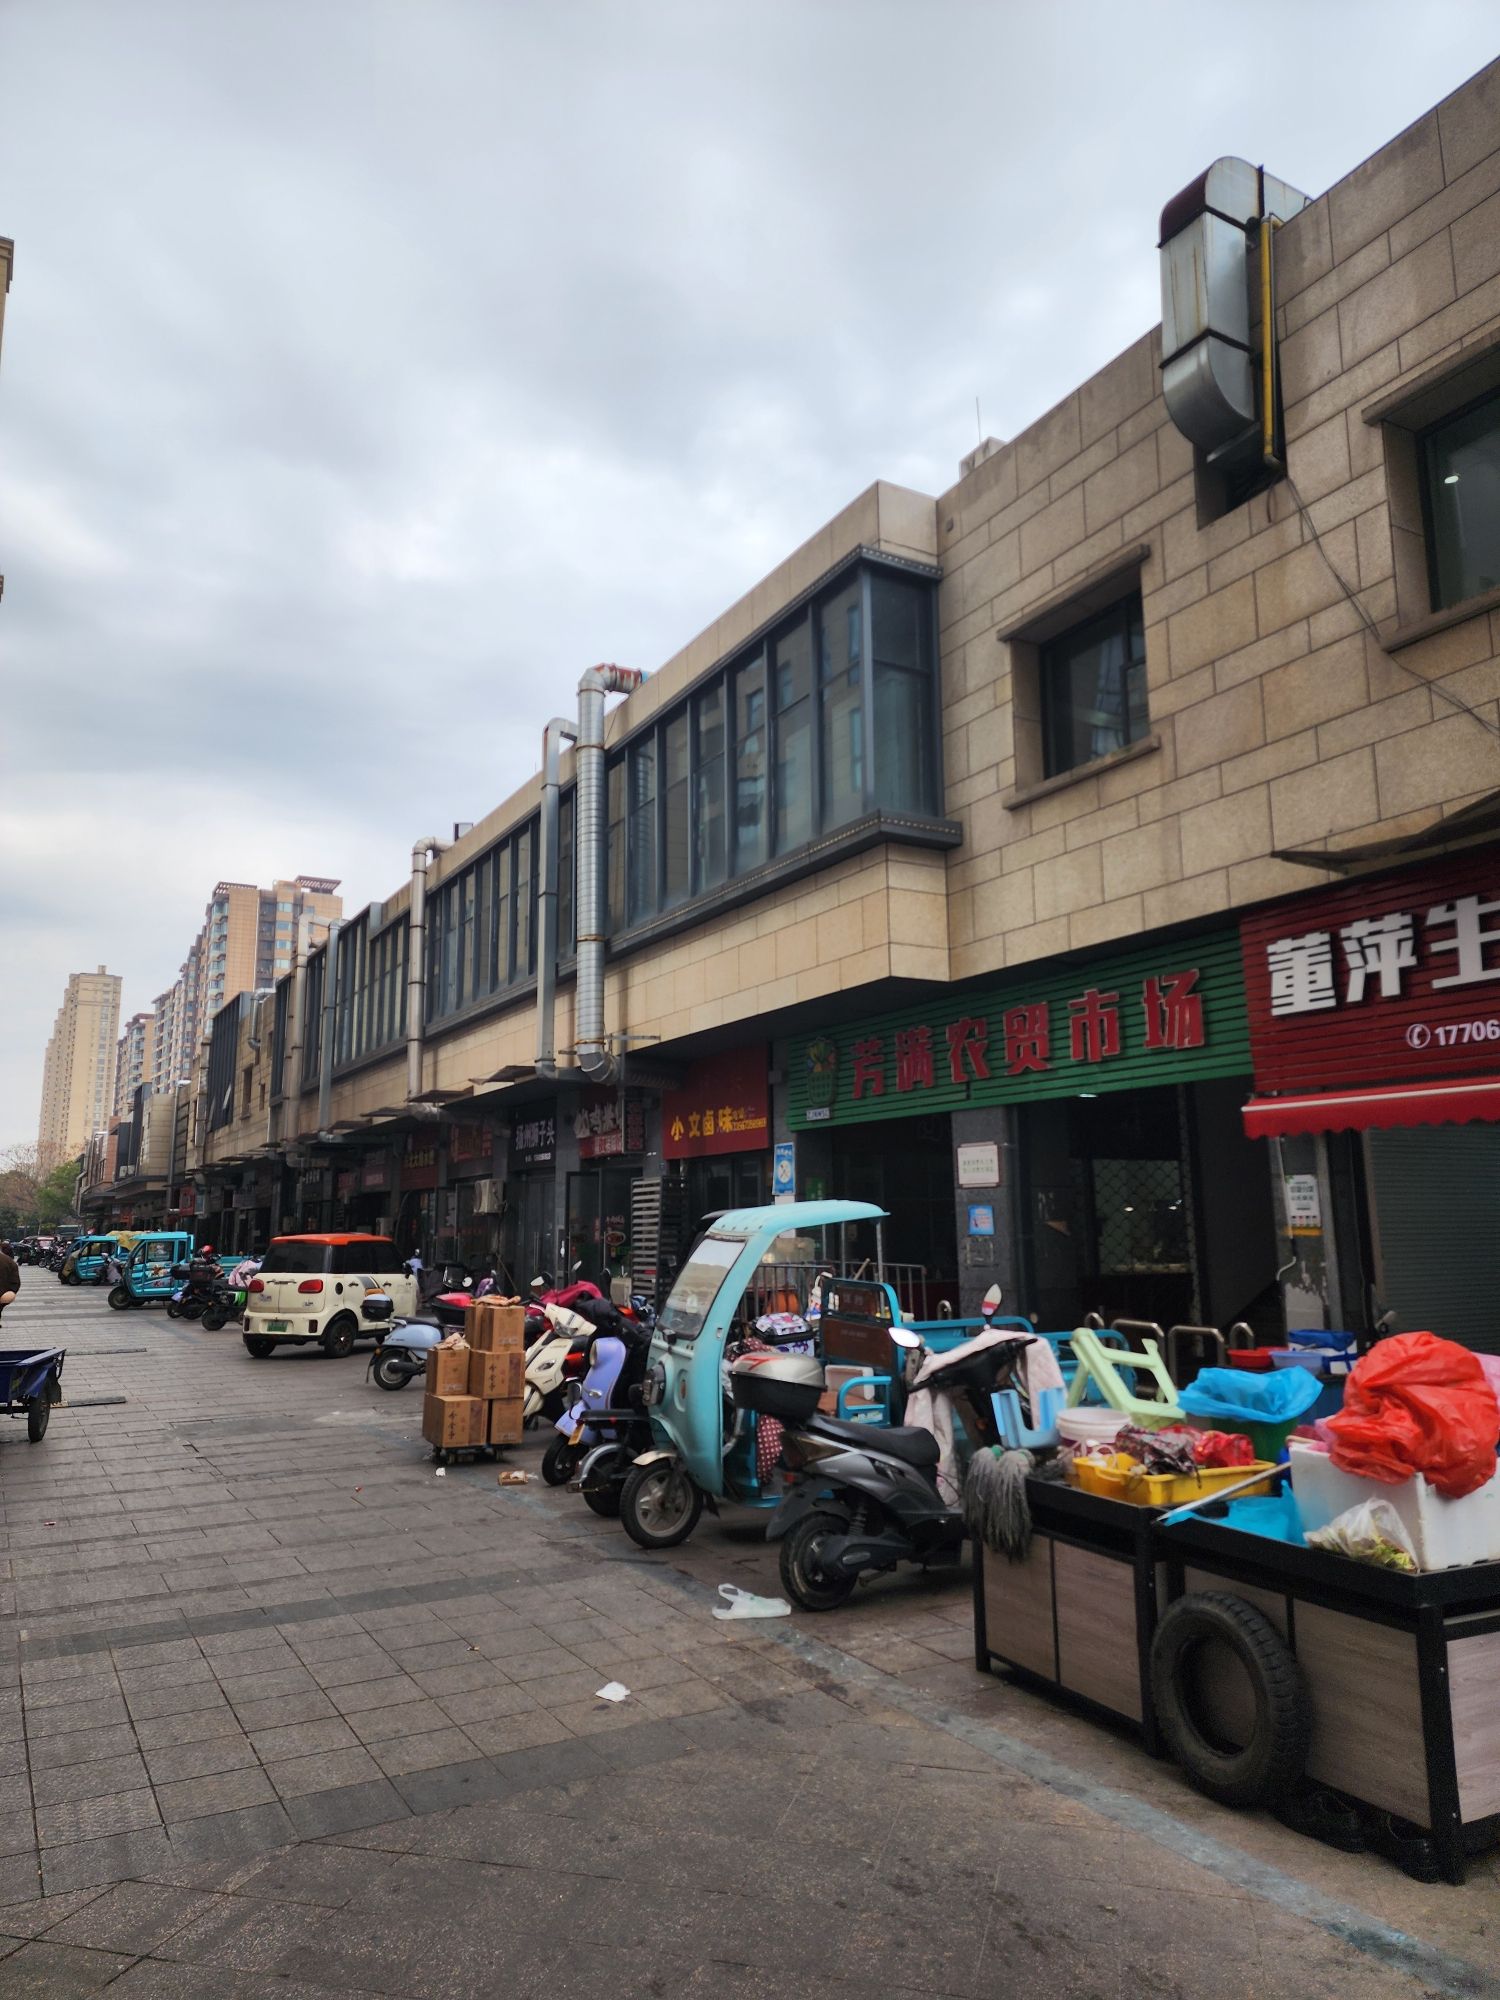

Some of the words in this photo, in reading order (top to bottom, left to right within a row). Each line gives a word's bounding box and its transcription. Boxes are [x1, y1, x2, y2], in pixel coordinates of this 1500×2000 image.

[1266, 894, 1500, 1016] 董萍生
[852, 968, 1205, 1099] 芳满农贸市场
[1434, 1019, 1500, 1046] 17706
